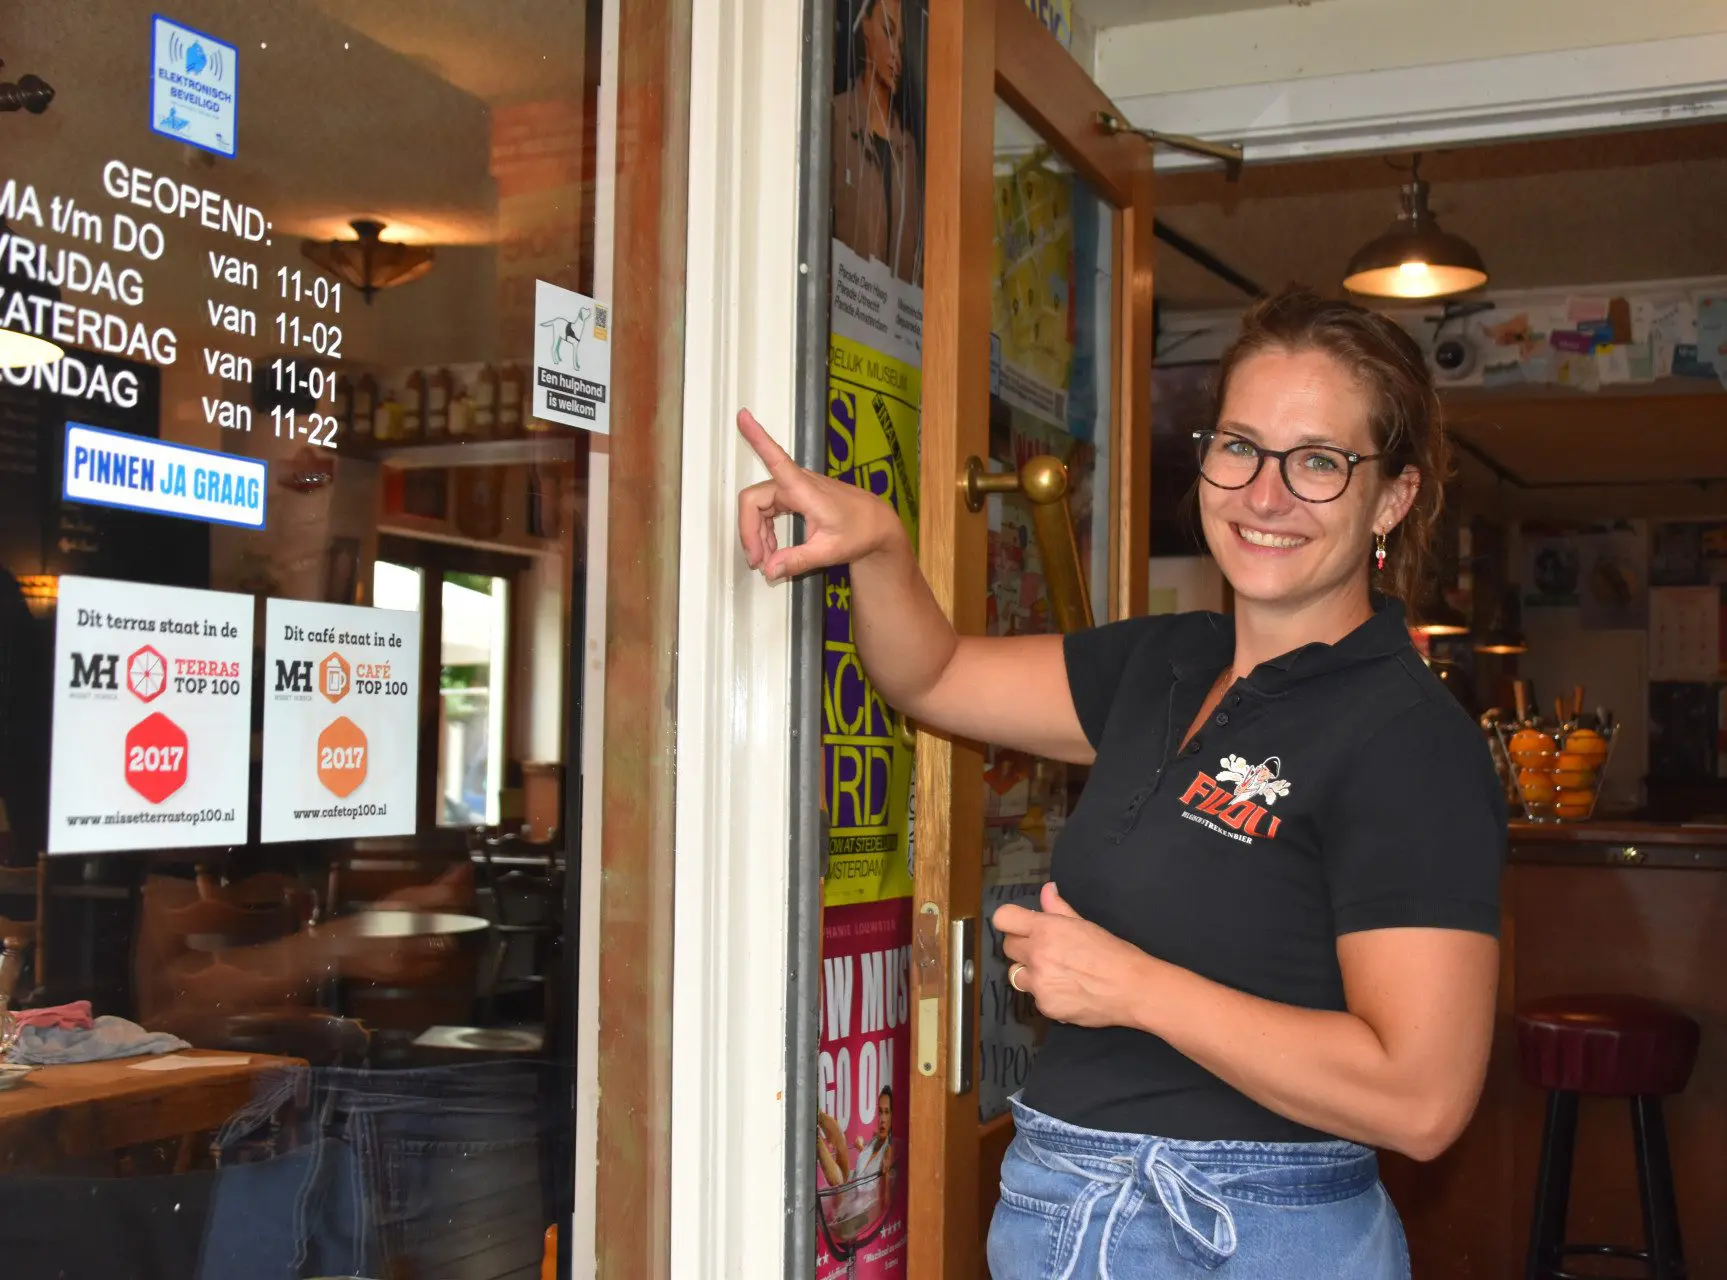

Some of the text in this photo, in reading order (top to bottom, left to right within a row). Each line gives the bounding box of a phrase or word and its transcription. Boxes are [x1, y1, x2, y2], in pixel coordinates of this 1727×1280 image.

[159, 68, 232, 103] ELEKTRONISCH
[170, 87, 220, 113] BEVEILIGD
[103, 160, 272, 246] GEOPEND:
[51, 197, 102, 243] t/m
[113, 214, 164, 260] DO
[209, 251, 258, 289] van
[277, 266, 341, 313] 11-01
[208, 300, 256, 336] van
[276, 313, 342, 359] 11-02
[0, 289, 336, 402] ATERDAG van 11-01
[541, 370, 603, 397] Een hulphond
[549, 393, 595, 417] is welkom
[202, 397, 251, 431] van
[271, 405, 338, 448] 11-22
[74, 445, 259, 509] PINNEN JA GRAAG
[77, 608, 238, 639] Dit terras staat in de
[284, 625, 402, 649] Dit café staat in de
[69, 652, 119, 690] MH
[174, 658, 240, 677] TERRAS
[275, 660, 313, 692] MH
[356, 660, 391, 678] CAFÉ
[174, 678, 240, 696] TOP 100
[356, 679, 408, 696] TOP 100
[128, 745, 184, 773] 2017
[320, 746, 364, 771] 2017
[67, 808, 235, 828] www.missetterrastop100.nl
[293, 804, 387, 821] www.cafetop100.nl
[1179, 771, 1282, 840] FILOU
